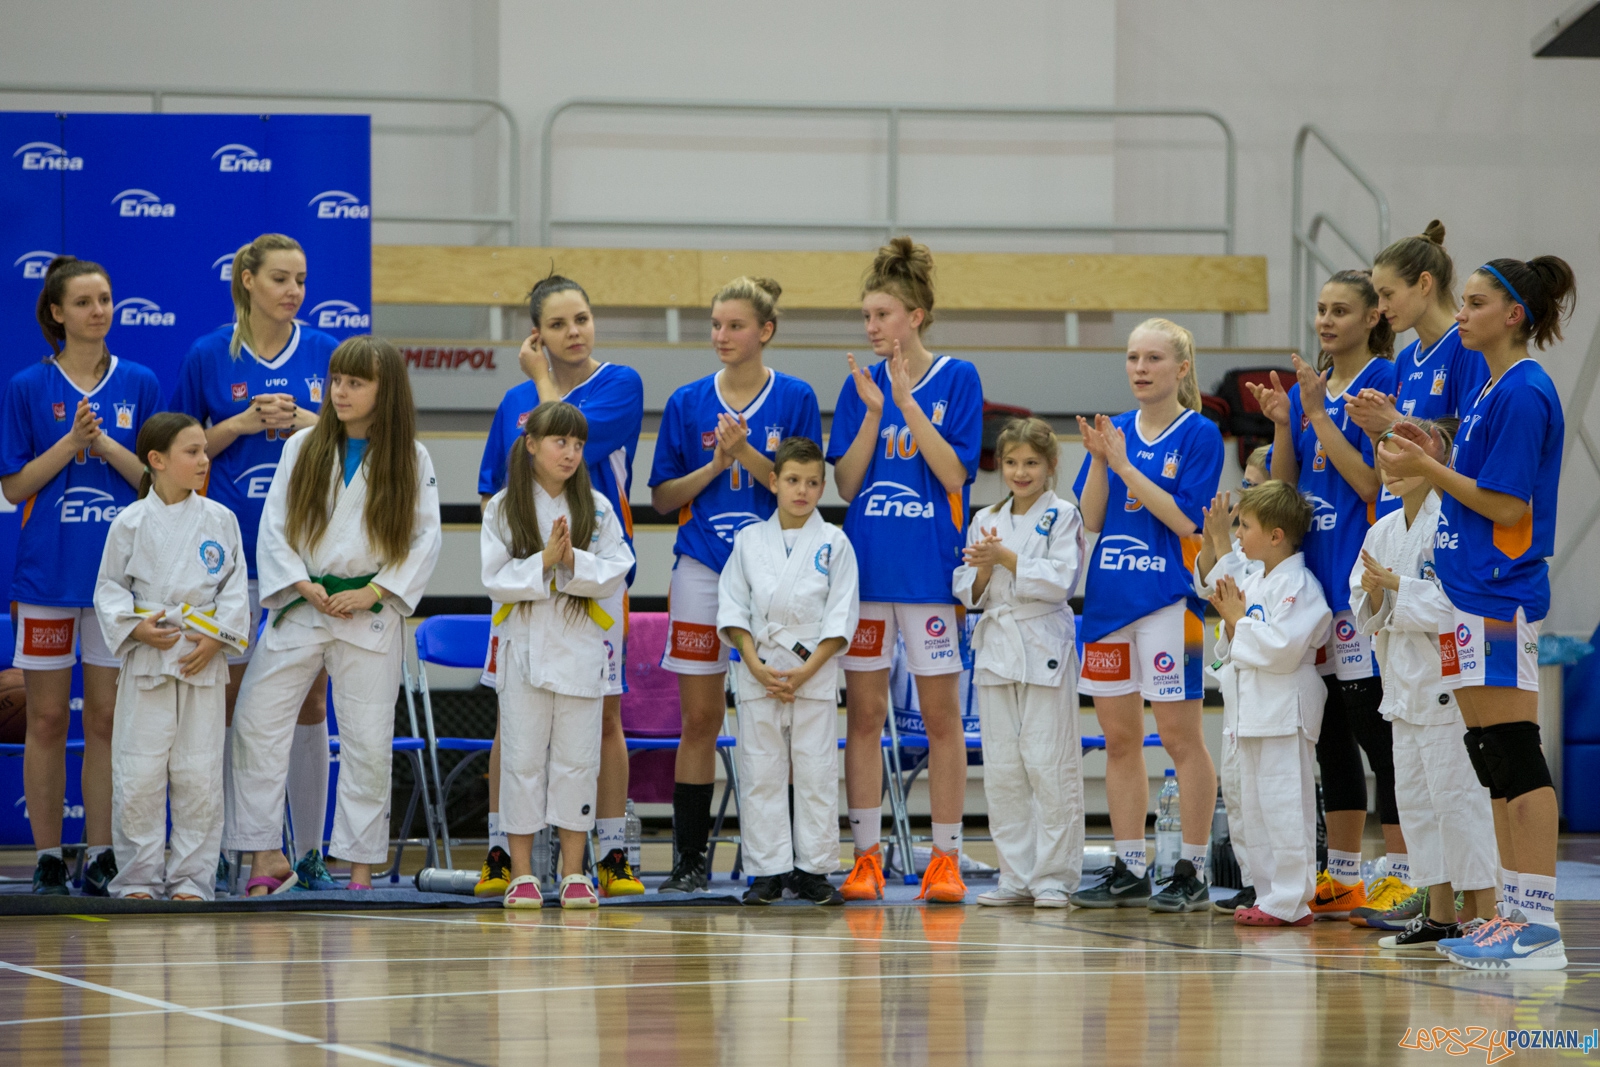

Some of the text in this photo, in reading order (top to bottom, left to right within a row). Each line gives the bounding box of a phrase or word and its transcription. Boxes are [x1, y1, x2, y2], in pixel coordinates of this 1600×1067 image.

[22, 153, 84, 171] Enea
[219, 155, 272, 172] Enea
[119, 199, 176, 217] Enea
[317, 201, 370, 219] Enea
[120, 308, 175, 326] Enea
[318, 310, 370, 328] Enea
[399, 348, 496, 369] MENPOL
[881, 424, 919, 460] 10
[864, 494, 935, 519] Enea
[1099, 547, 1167, 573] Enea
[1087, 658, 1122, 668] SZPIKU
[1521, 900, 1535, 909] AZS
